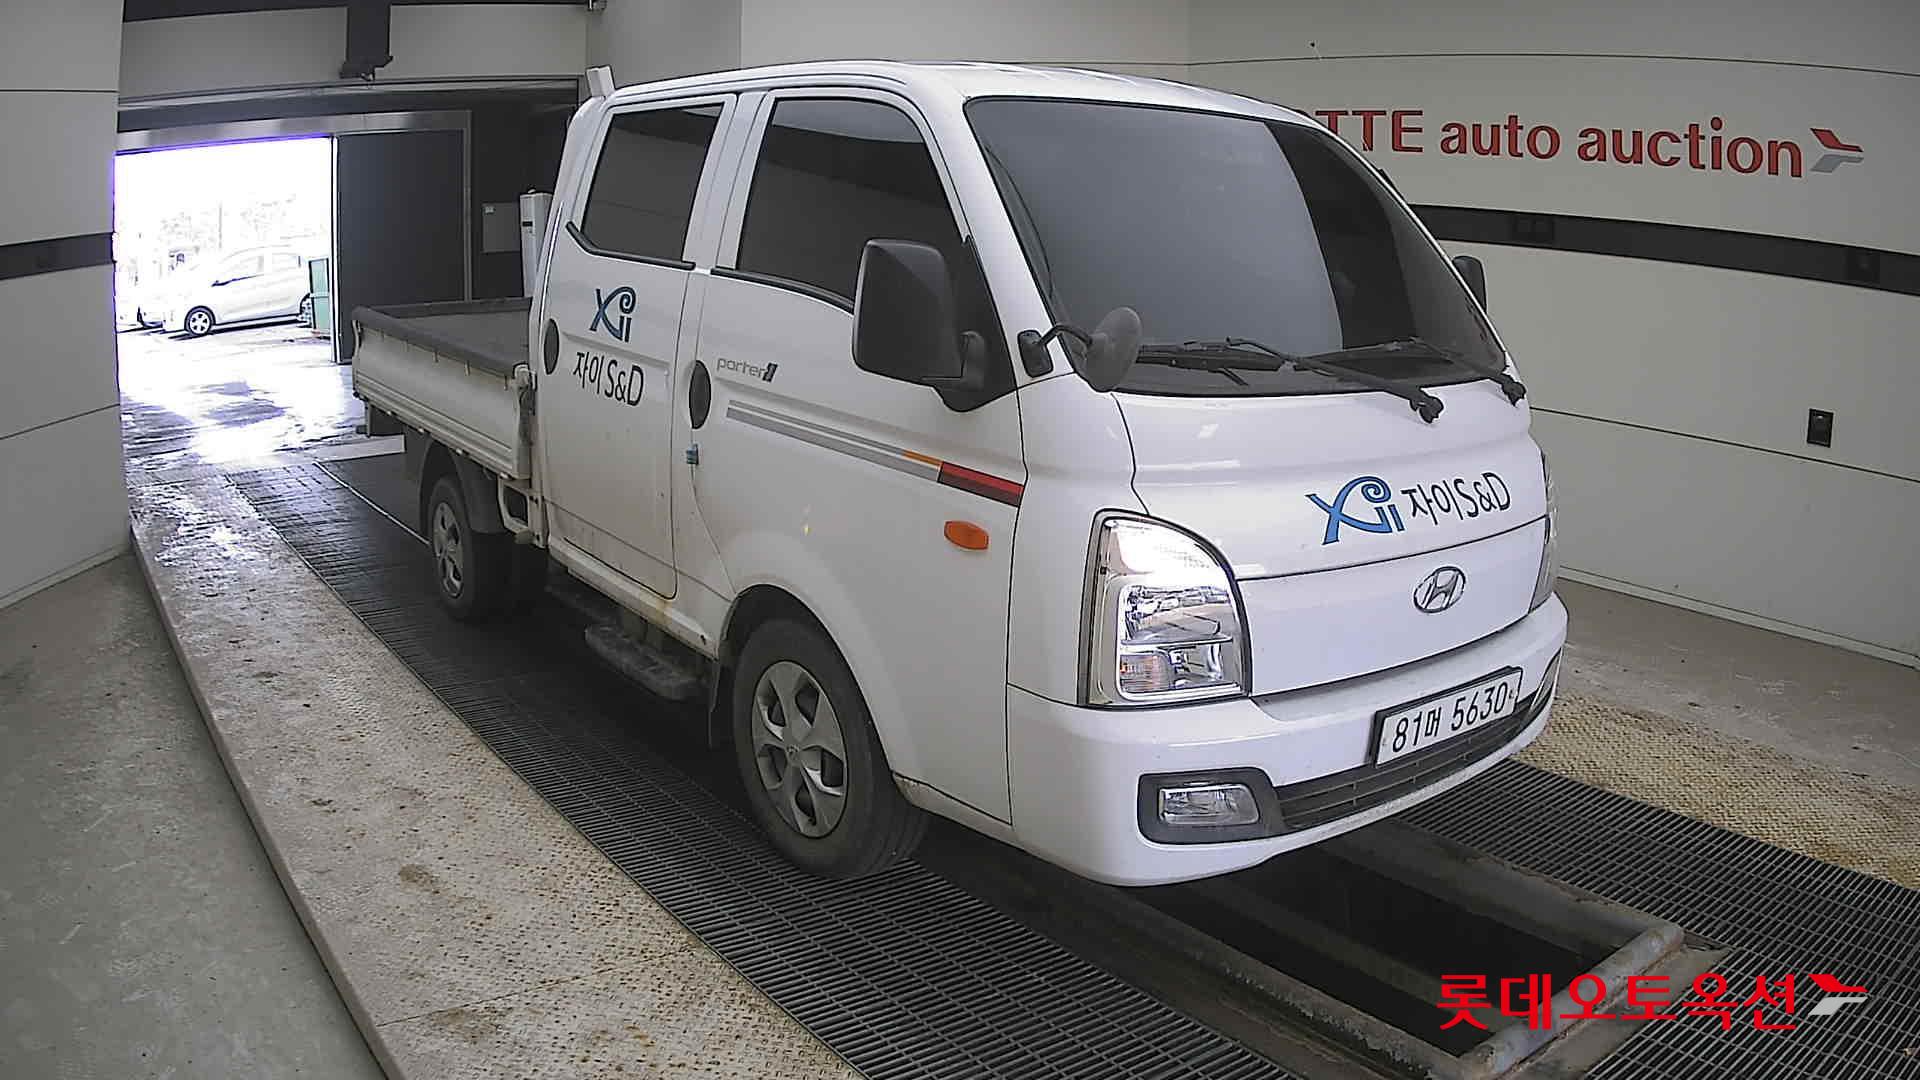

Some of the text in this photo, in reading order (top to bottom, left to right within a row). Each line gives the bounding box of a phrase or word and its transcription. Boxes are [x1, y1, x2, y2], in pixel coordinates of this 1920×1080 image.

[1294, 109, 1803, 179] TTE auto auction
[1450, 681, 1509, 732] 5630
